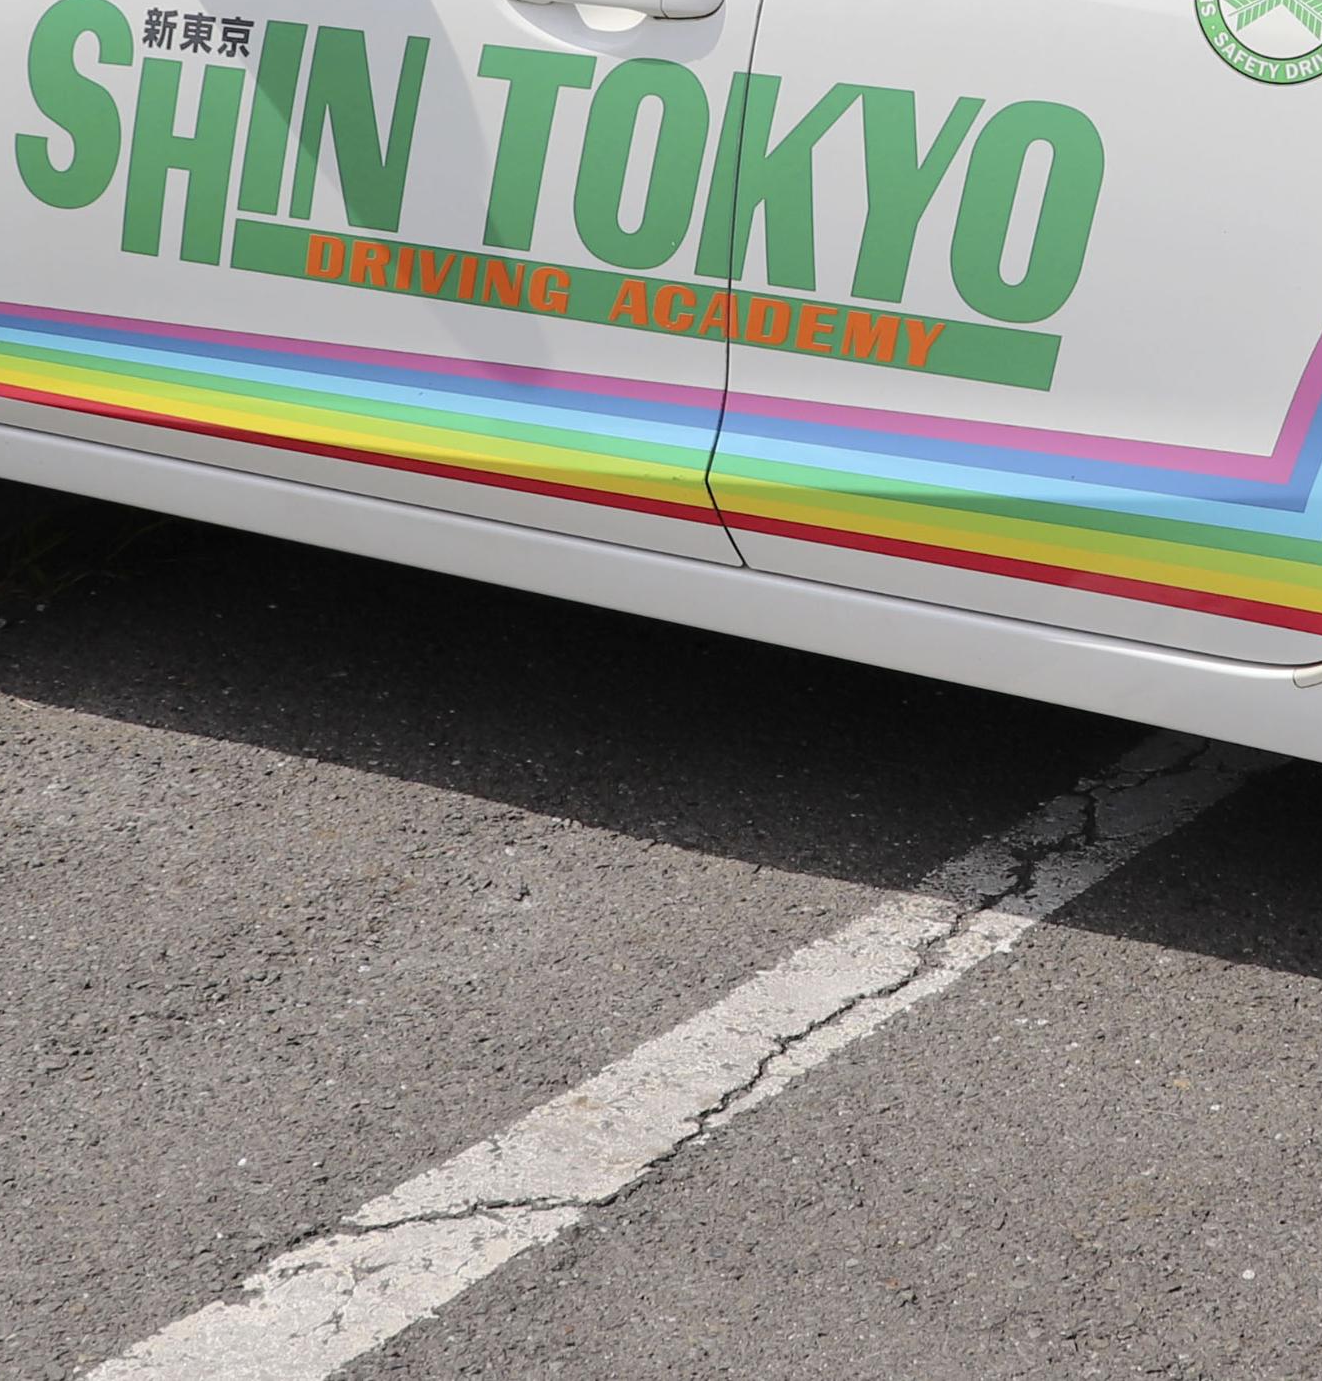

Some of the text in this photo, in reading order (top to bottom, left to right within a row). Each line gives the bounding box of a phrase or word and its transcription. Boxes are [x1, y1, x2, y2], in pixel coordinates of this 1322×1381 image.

[142, 7, 255, 57] 新東京
[1214, 31, 1281, 79] SAFETY
[476, 43, 1105, 323] TOKYO
[304, 234, 946, 368] DRIVING ACADEMY
